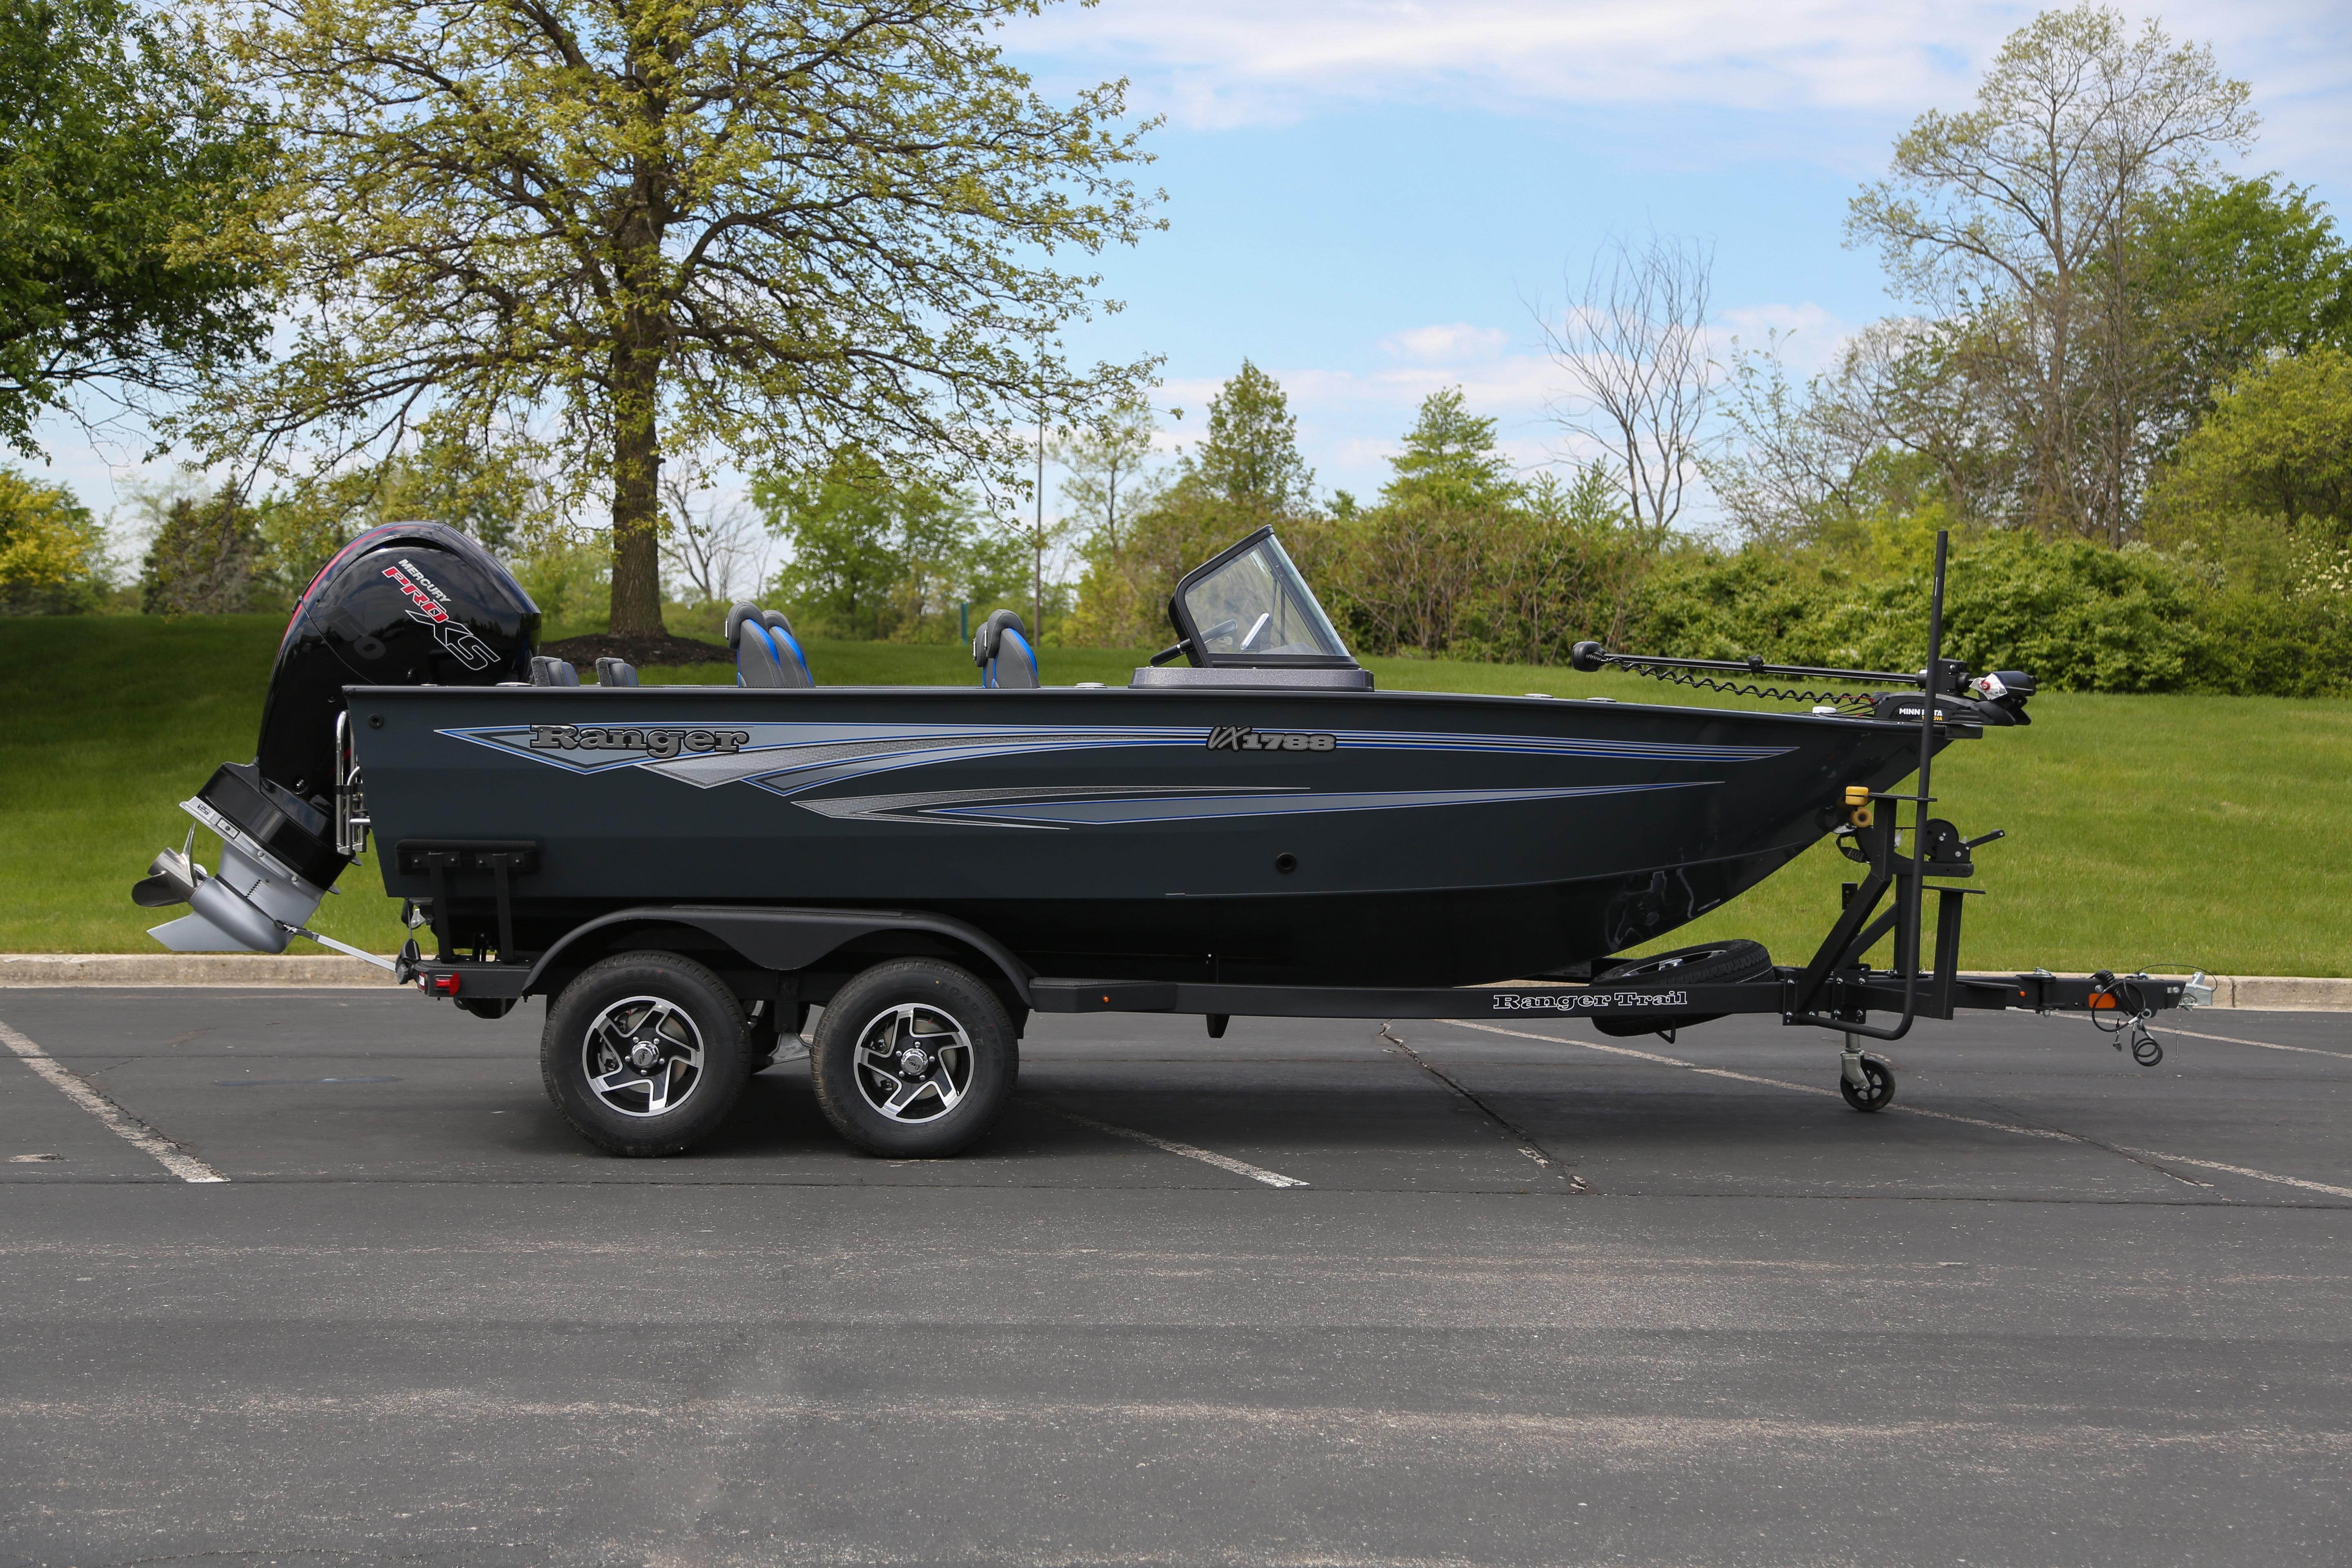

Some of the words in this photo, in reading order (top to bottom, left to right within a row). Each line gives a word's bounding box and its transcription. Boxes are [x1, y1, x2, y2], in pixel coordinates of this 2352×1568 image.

[382, 566, 449, 623] PRO
[398, 559, 452, 603] MERCURY
[405, 609, 501, 671] XS
[531, 724, 748, 758] Ranger
[940, 982, 979, 1013] LOAD
[1493, 993, 1611, 1011] Ranger
[1614, 991, 1687, 1006] Trail
